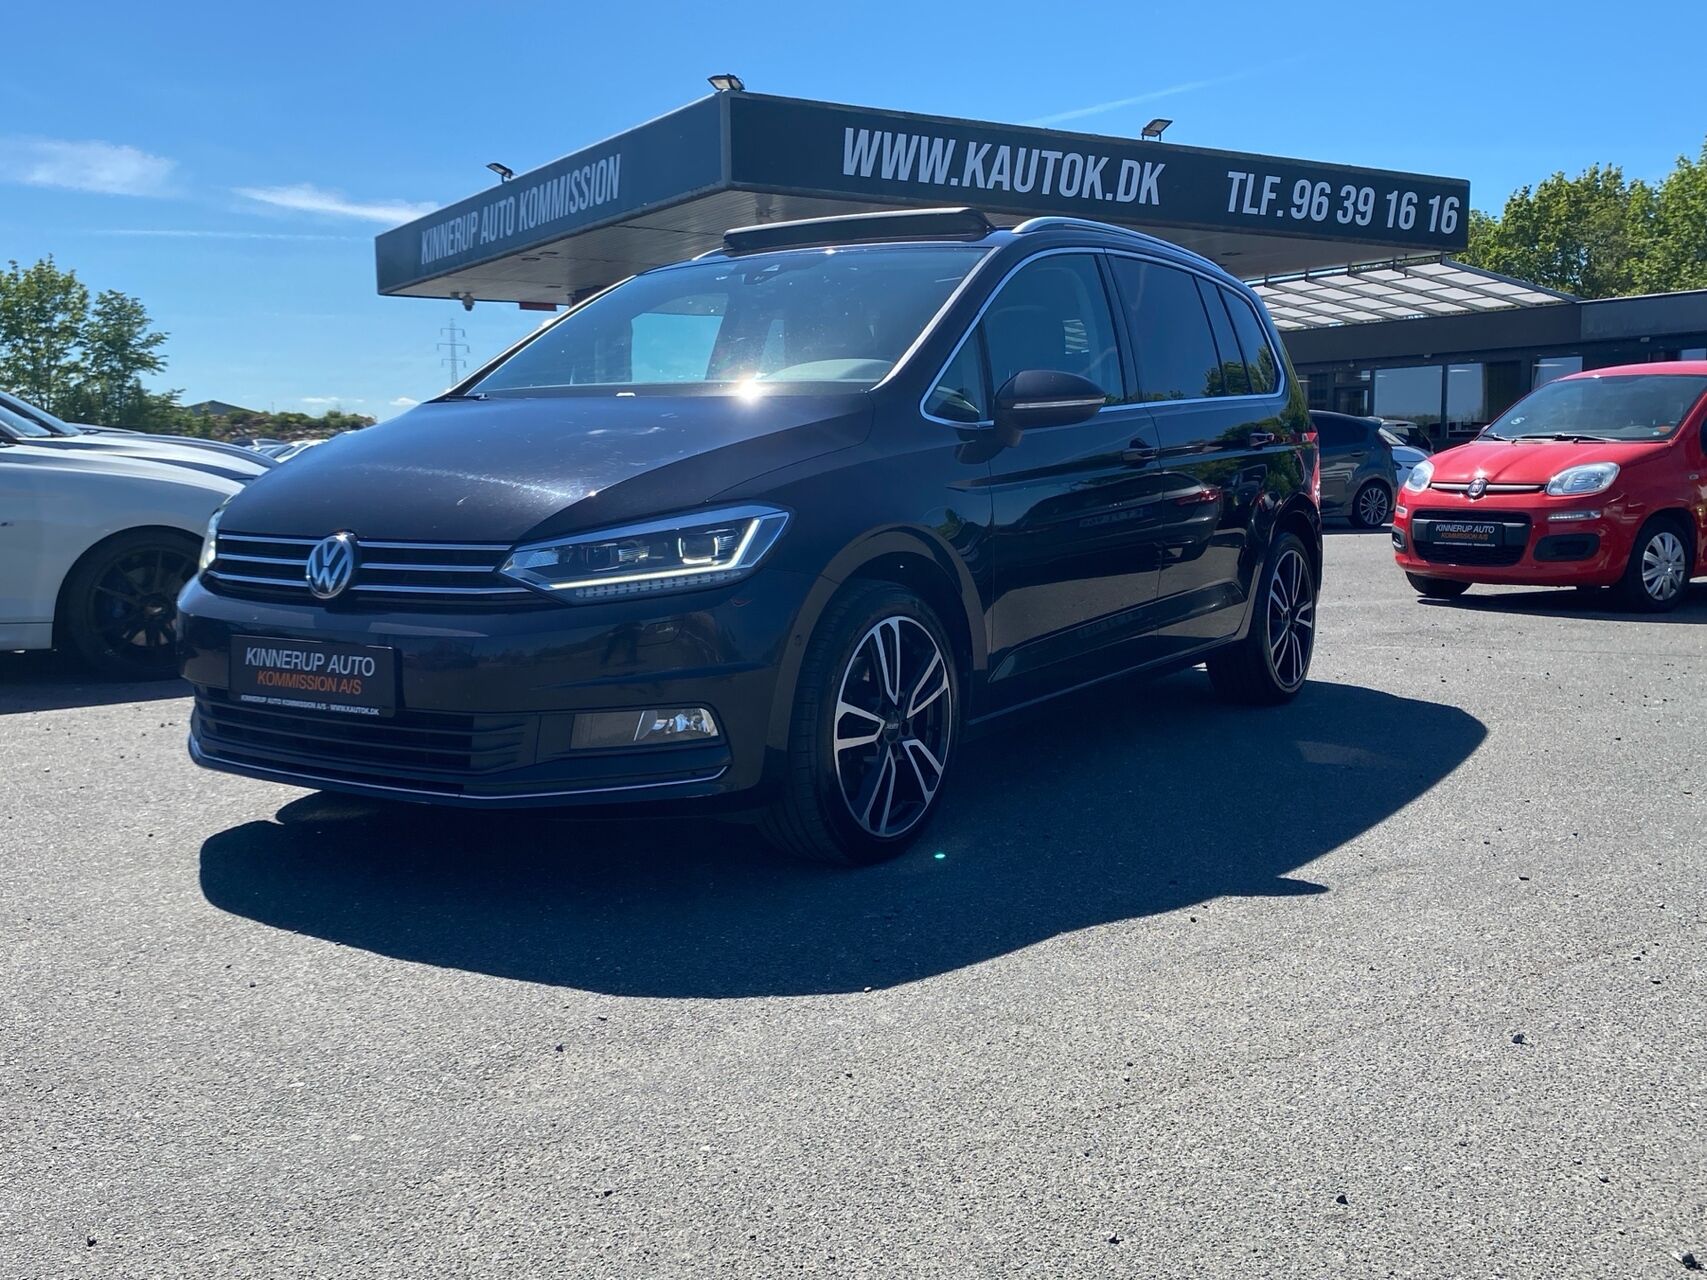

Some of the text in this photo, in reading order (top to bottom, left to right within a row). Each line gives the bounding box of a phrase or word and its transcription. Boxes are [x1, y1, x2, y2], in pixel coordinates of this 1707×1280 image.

[843, 127, 1166, 206] WWW.KAUTOK.DK
[421, 153, 621, 265] KINNERUP AUTO KOMMISSION
[1227, 171, 1460, 234] TLF. 96 39 16 16
[1435, 524, 1495, 534] KINNERUP AUTO
[245, 647, 375, 677] KINNERUP AUTO
[257, 670, 362, 695] KOMMISSION A/S
